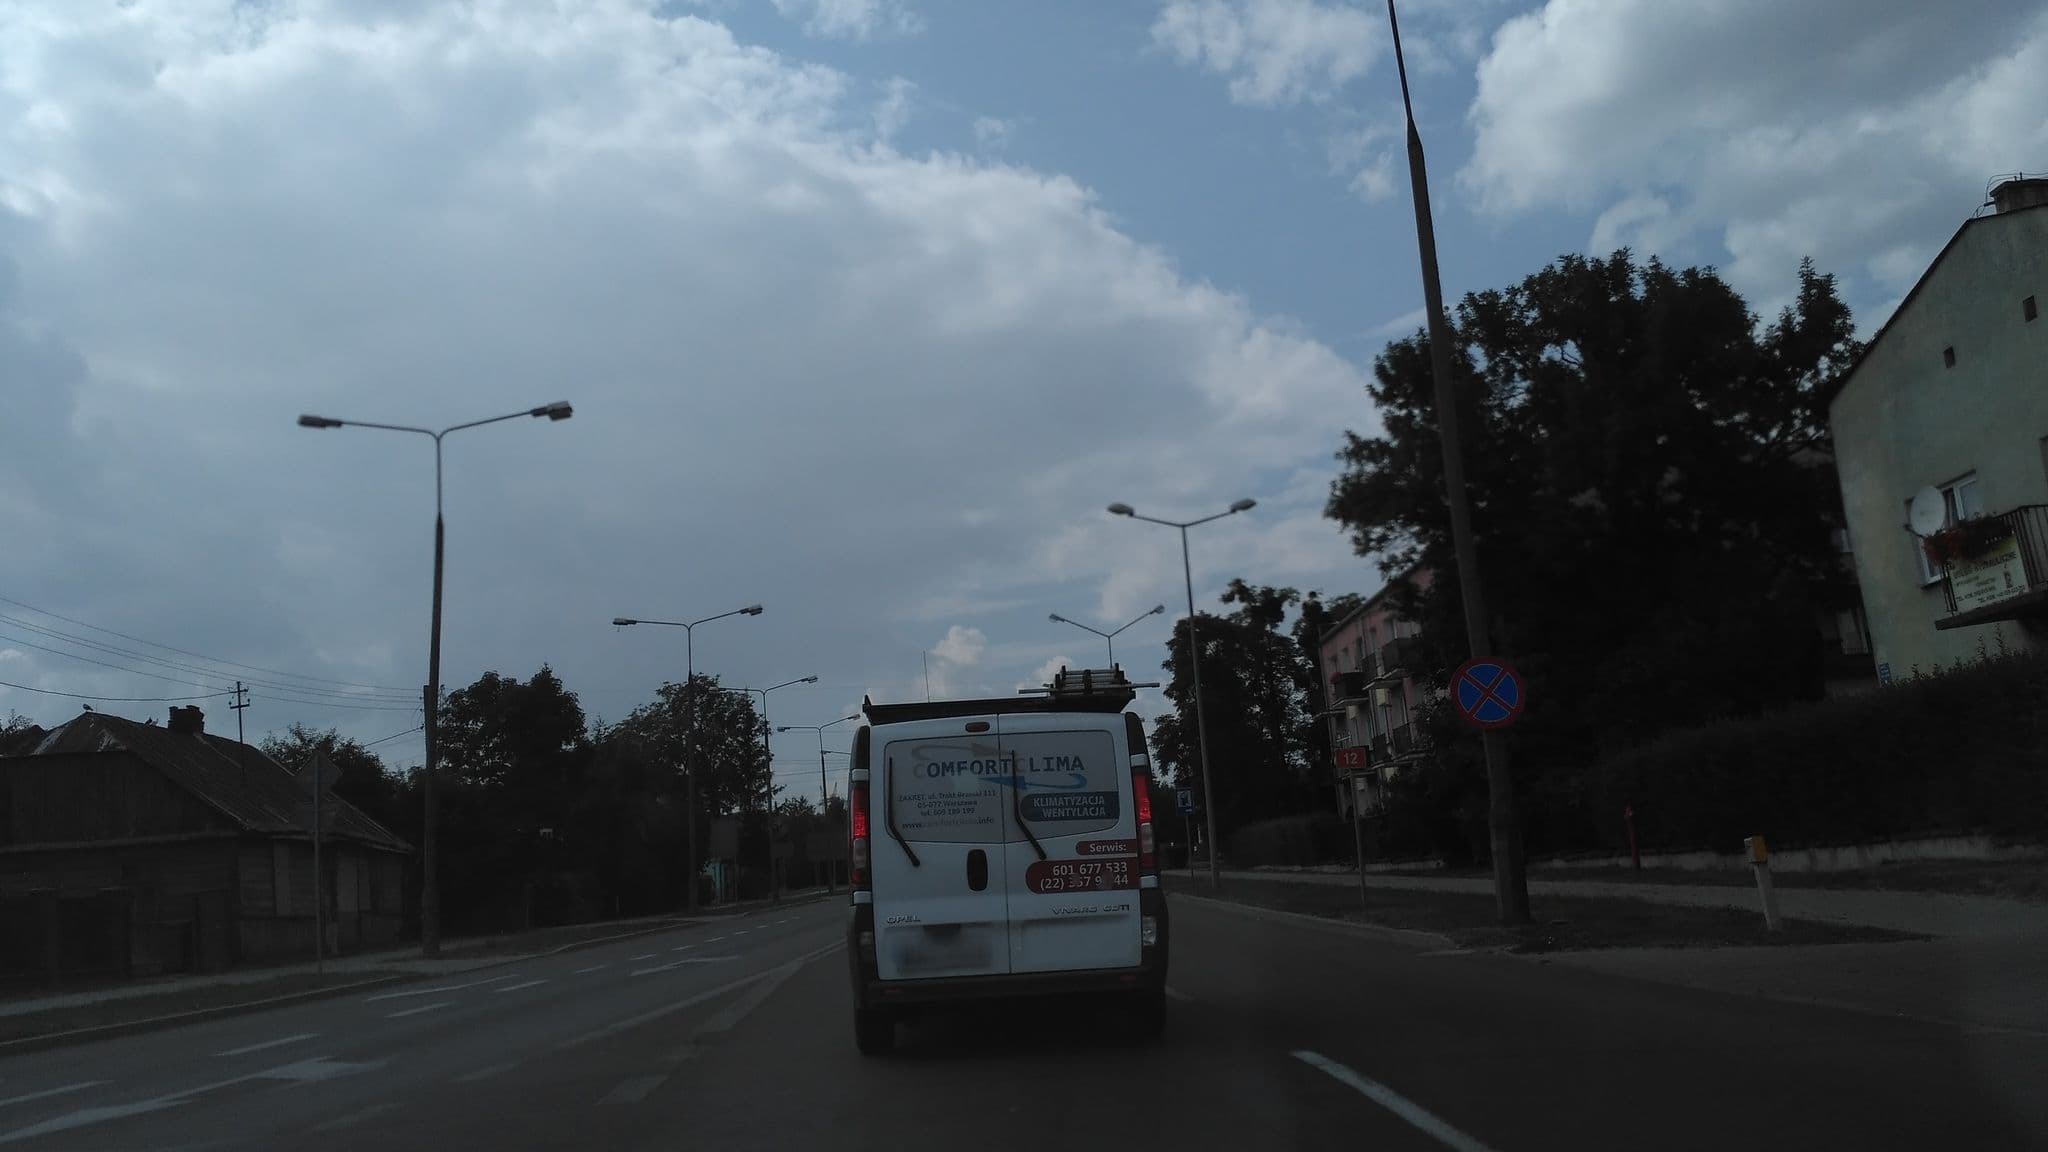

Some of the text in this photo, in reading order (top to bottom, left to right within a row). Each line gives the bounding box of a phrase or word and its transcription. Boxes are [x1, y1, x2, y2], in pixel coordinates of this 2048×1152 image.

[1343, 752, 1358, 765] 12
[1033, 795, 1105, 807] KLIMATYZACJA
[1042, 806, 1106, 818] WENTYLACJA
[1089, 842, 1127, 853] Serwis:
[1053, 861, 1128, 876] 601 677 533
[1040, 878, 1064, 891] (22)
[886, 913, 921, 924] OPEL
